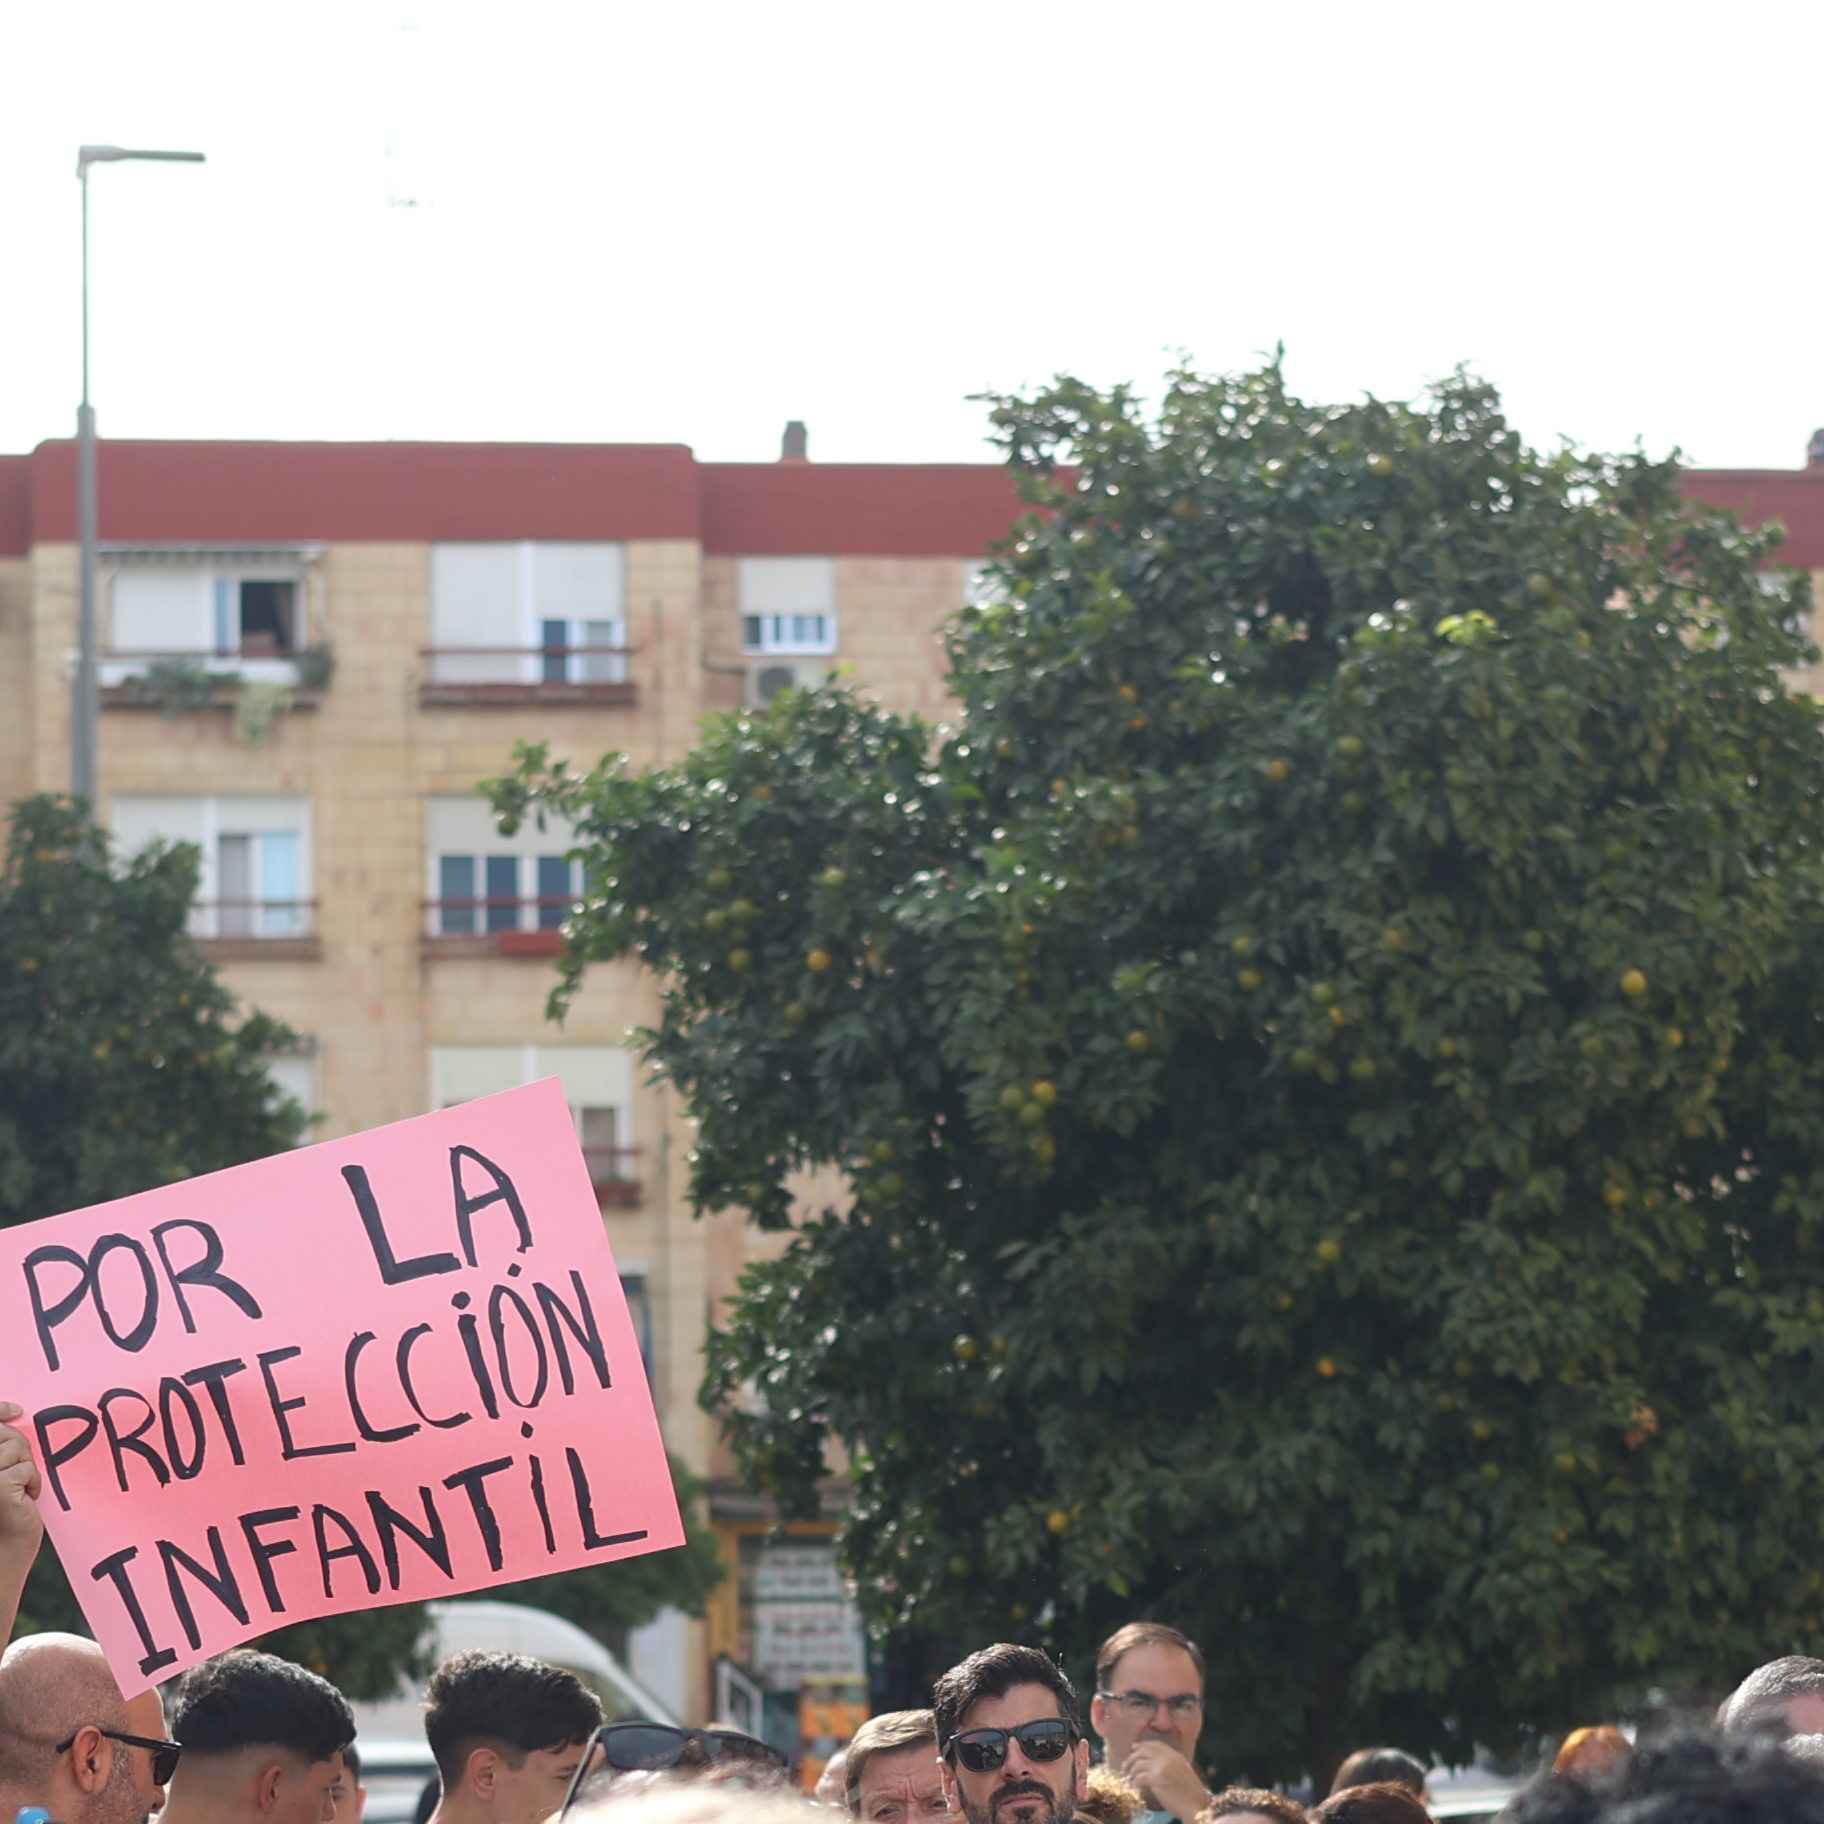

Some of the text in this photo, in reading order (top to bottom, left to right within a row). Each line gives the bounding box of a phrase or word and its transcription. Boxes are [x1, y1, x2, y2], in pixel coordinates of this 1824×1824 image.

[21, 1145, 533, 1371] POR LA
[91, 1422, 648, 1676] INFANTIL
